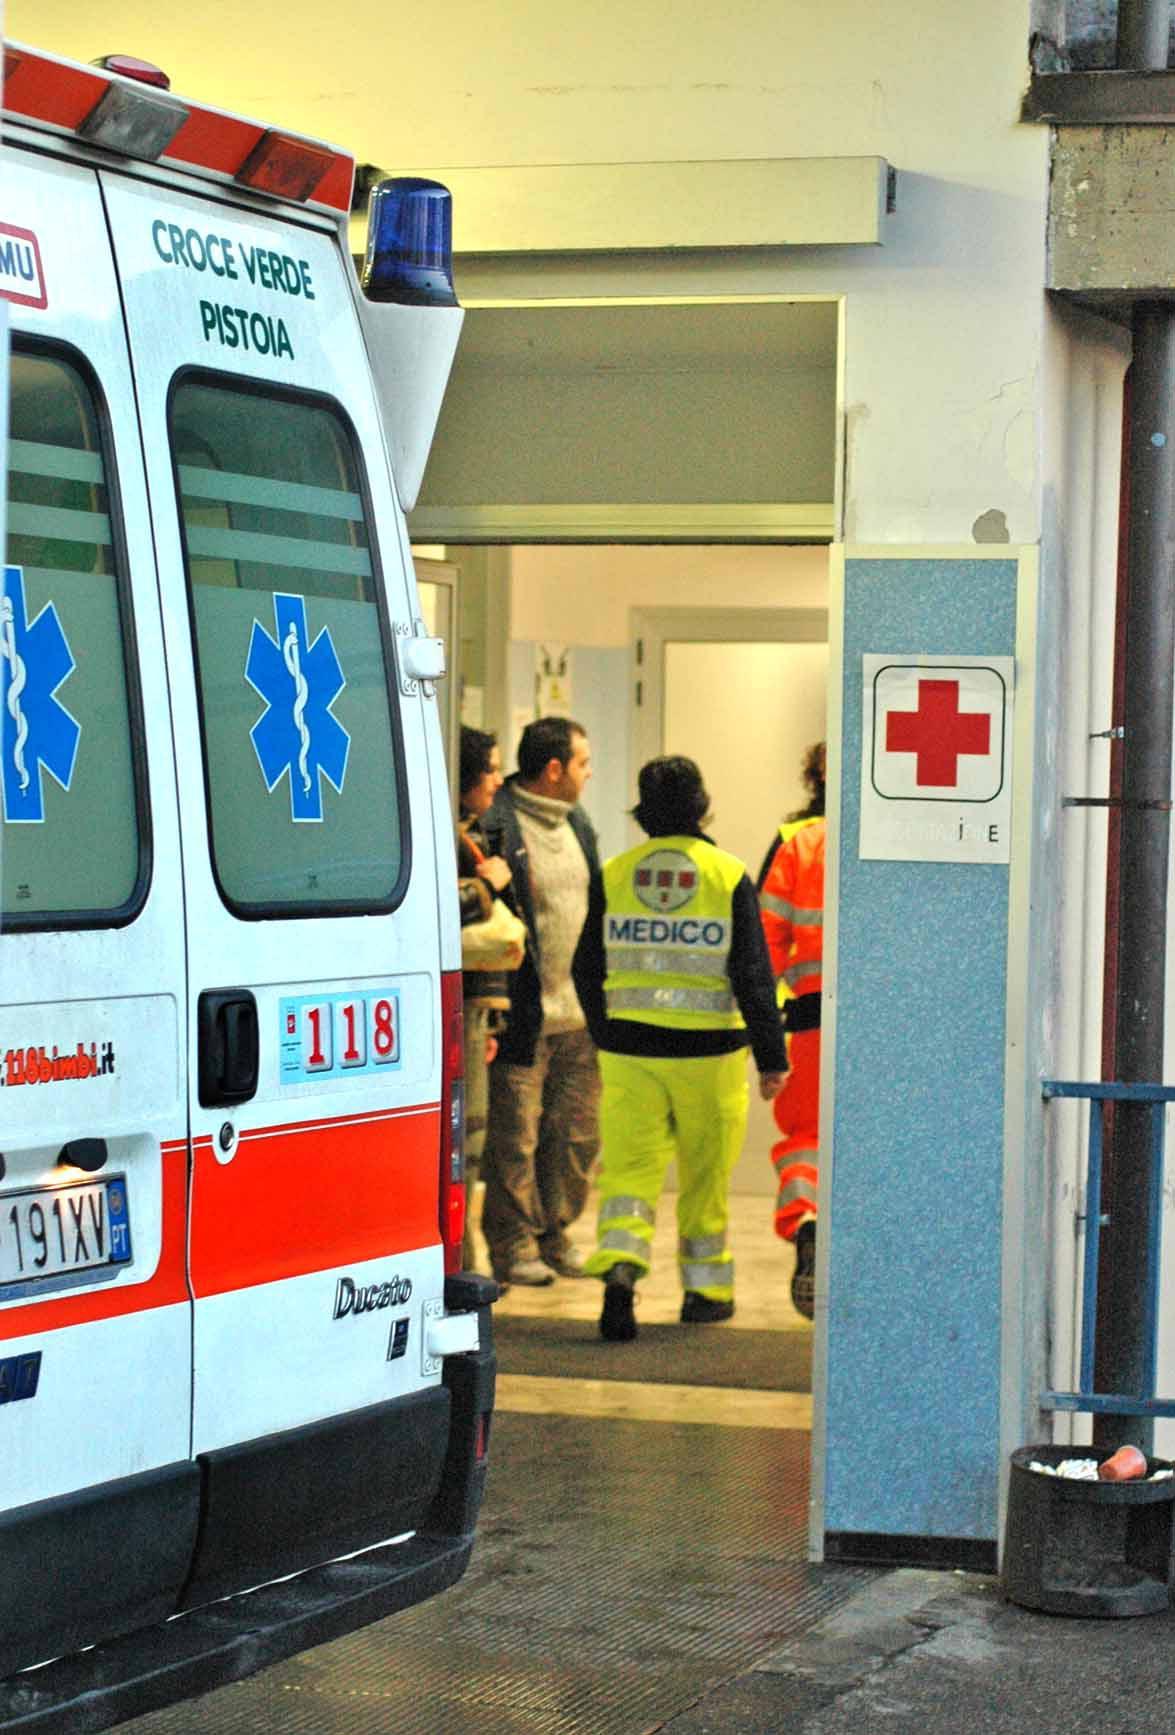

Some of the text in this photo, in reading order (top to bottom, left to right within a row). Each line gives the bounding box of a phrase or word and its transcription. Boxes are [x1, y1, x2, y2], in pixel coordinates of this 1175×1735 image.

[152, 219, 315, 300] CROCE VERDE
[200, 300, 294, 360] PISTOIA
[608, 918, 724, 946] MEDICO
[308, 1000, 394, 1065] 118
[10, 1191, 127, 1272] 191XV PT
[333, 1275, 412, 1320] Ducato
